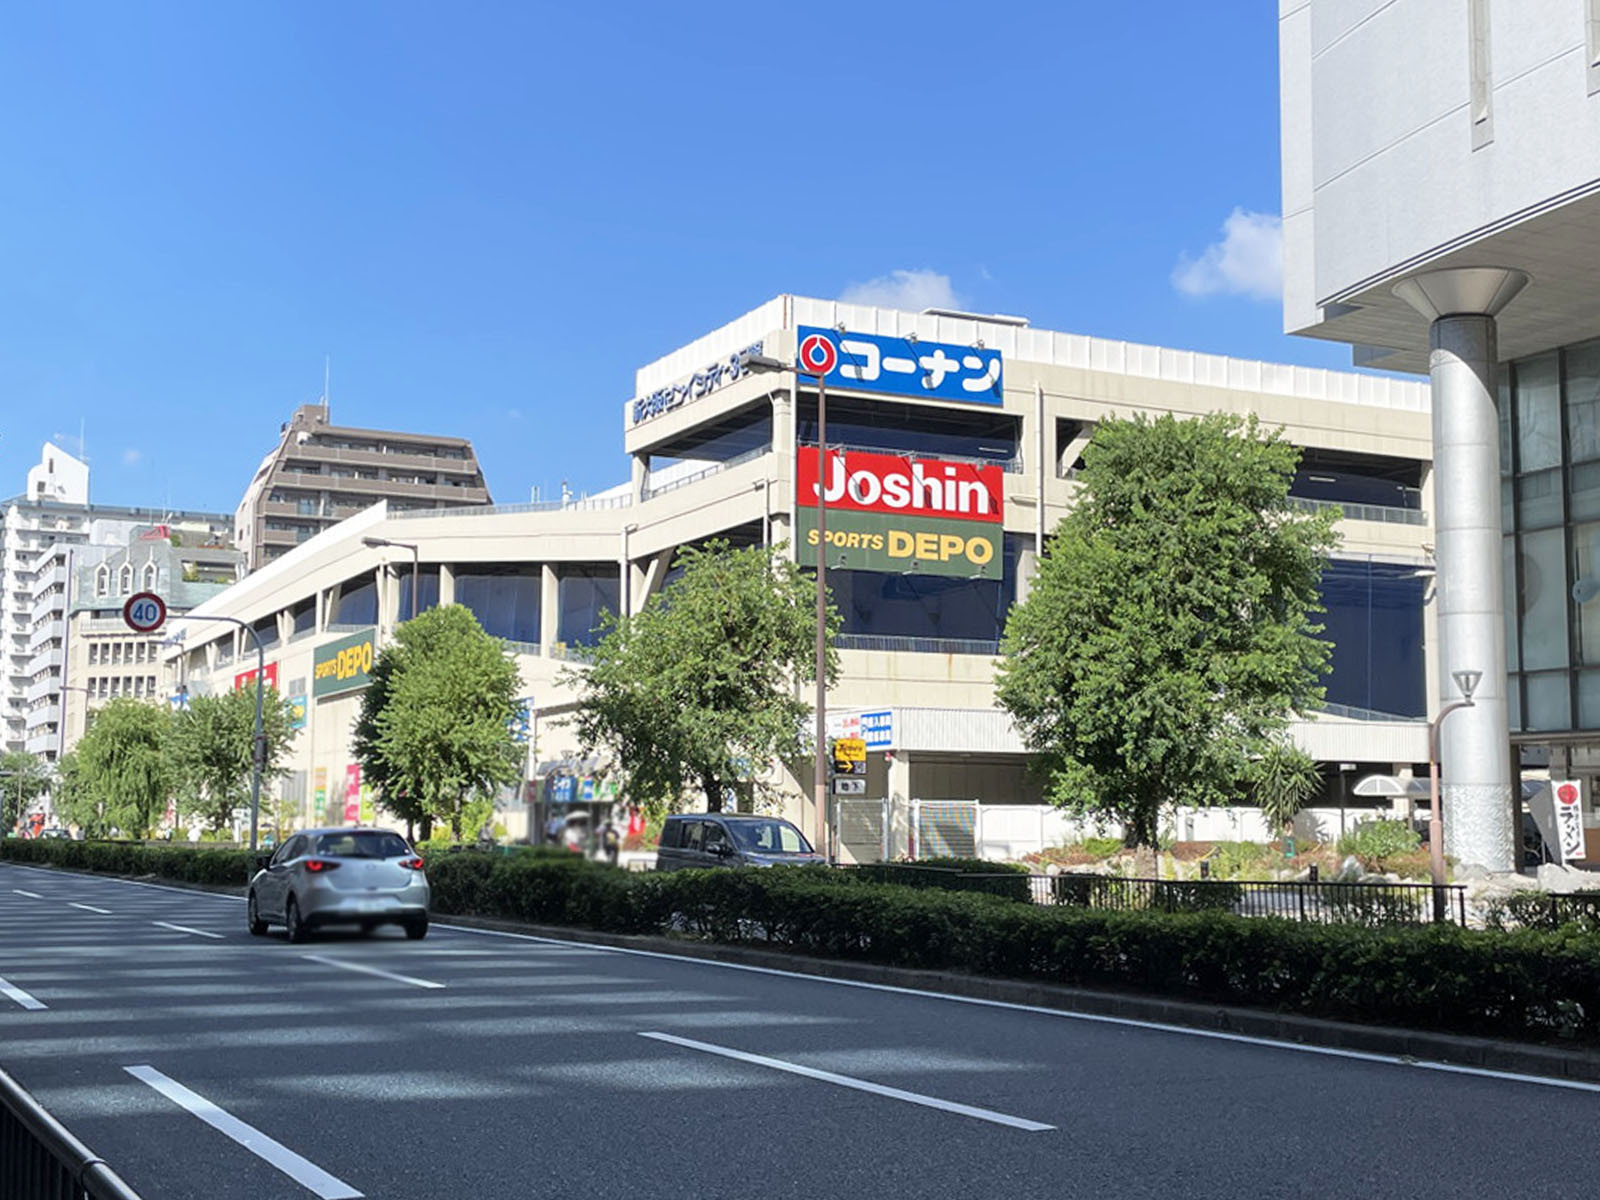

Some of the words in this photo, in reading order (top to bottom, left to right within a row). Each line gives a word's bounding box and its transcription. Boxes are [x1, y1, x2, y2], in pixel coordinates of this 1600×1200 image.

[839, 340, 1001, 392] コーナン
[813, 456, 989, 514] Joshin
[887, 530, 994, 565] DEPO
[133, 603, 157, 622] 40
[337, 641, 372, 680] DEPO
